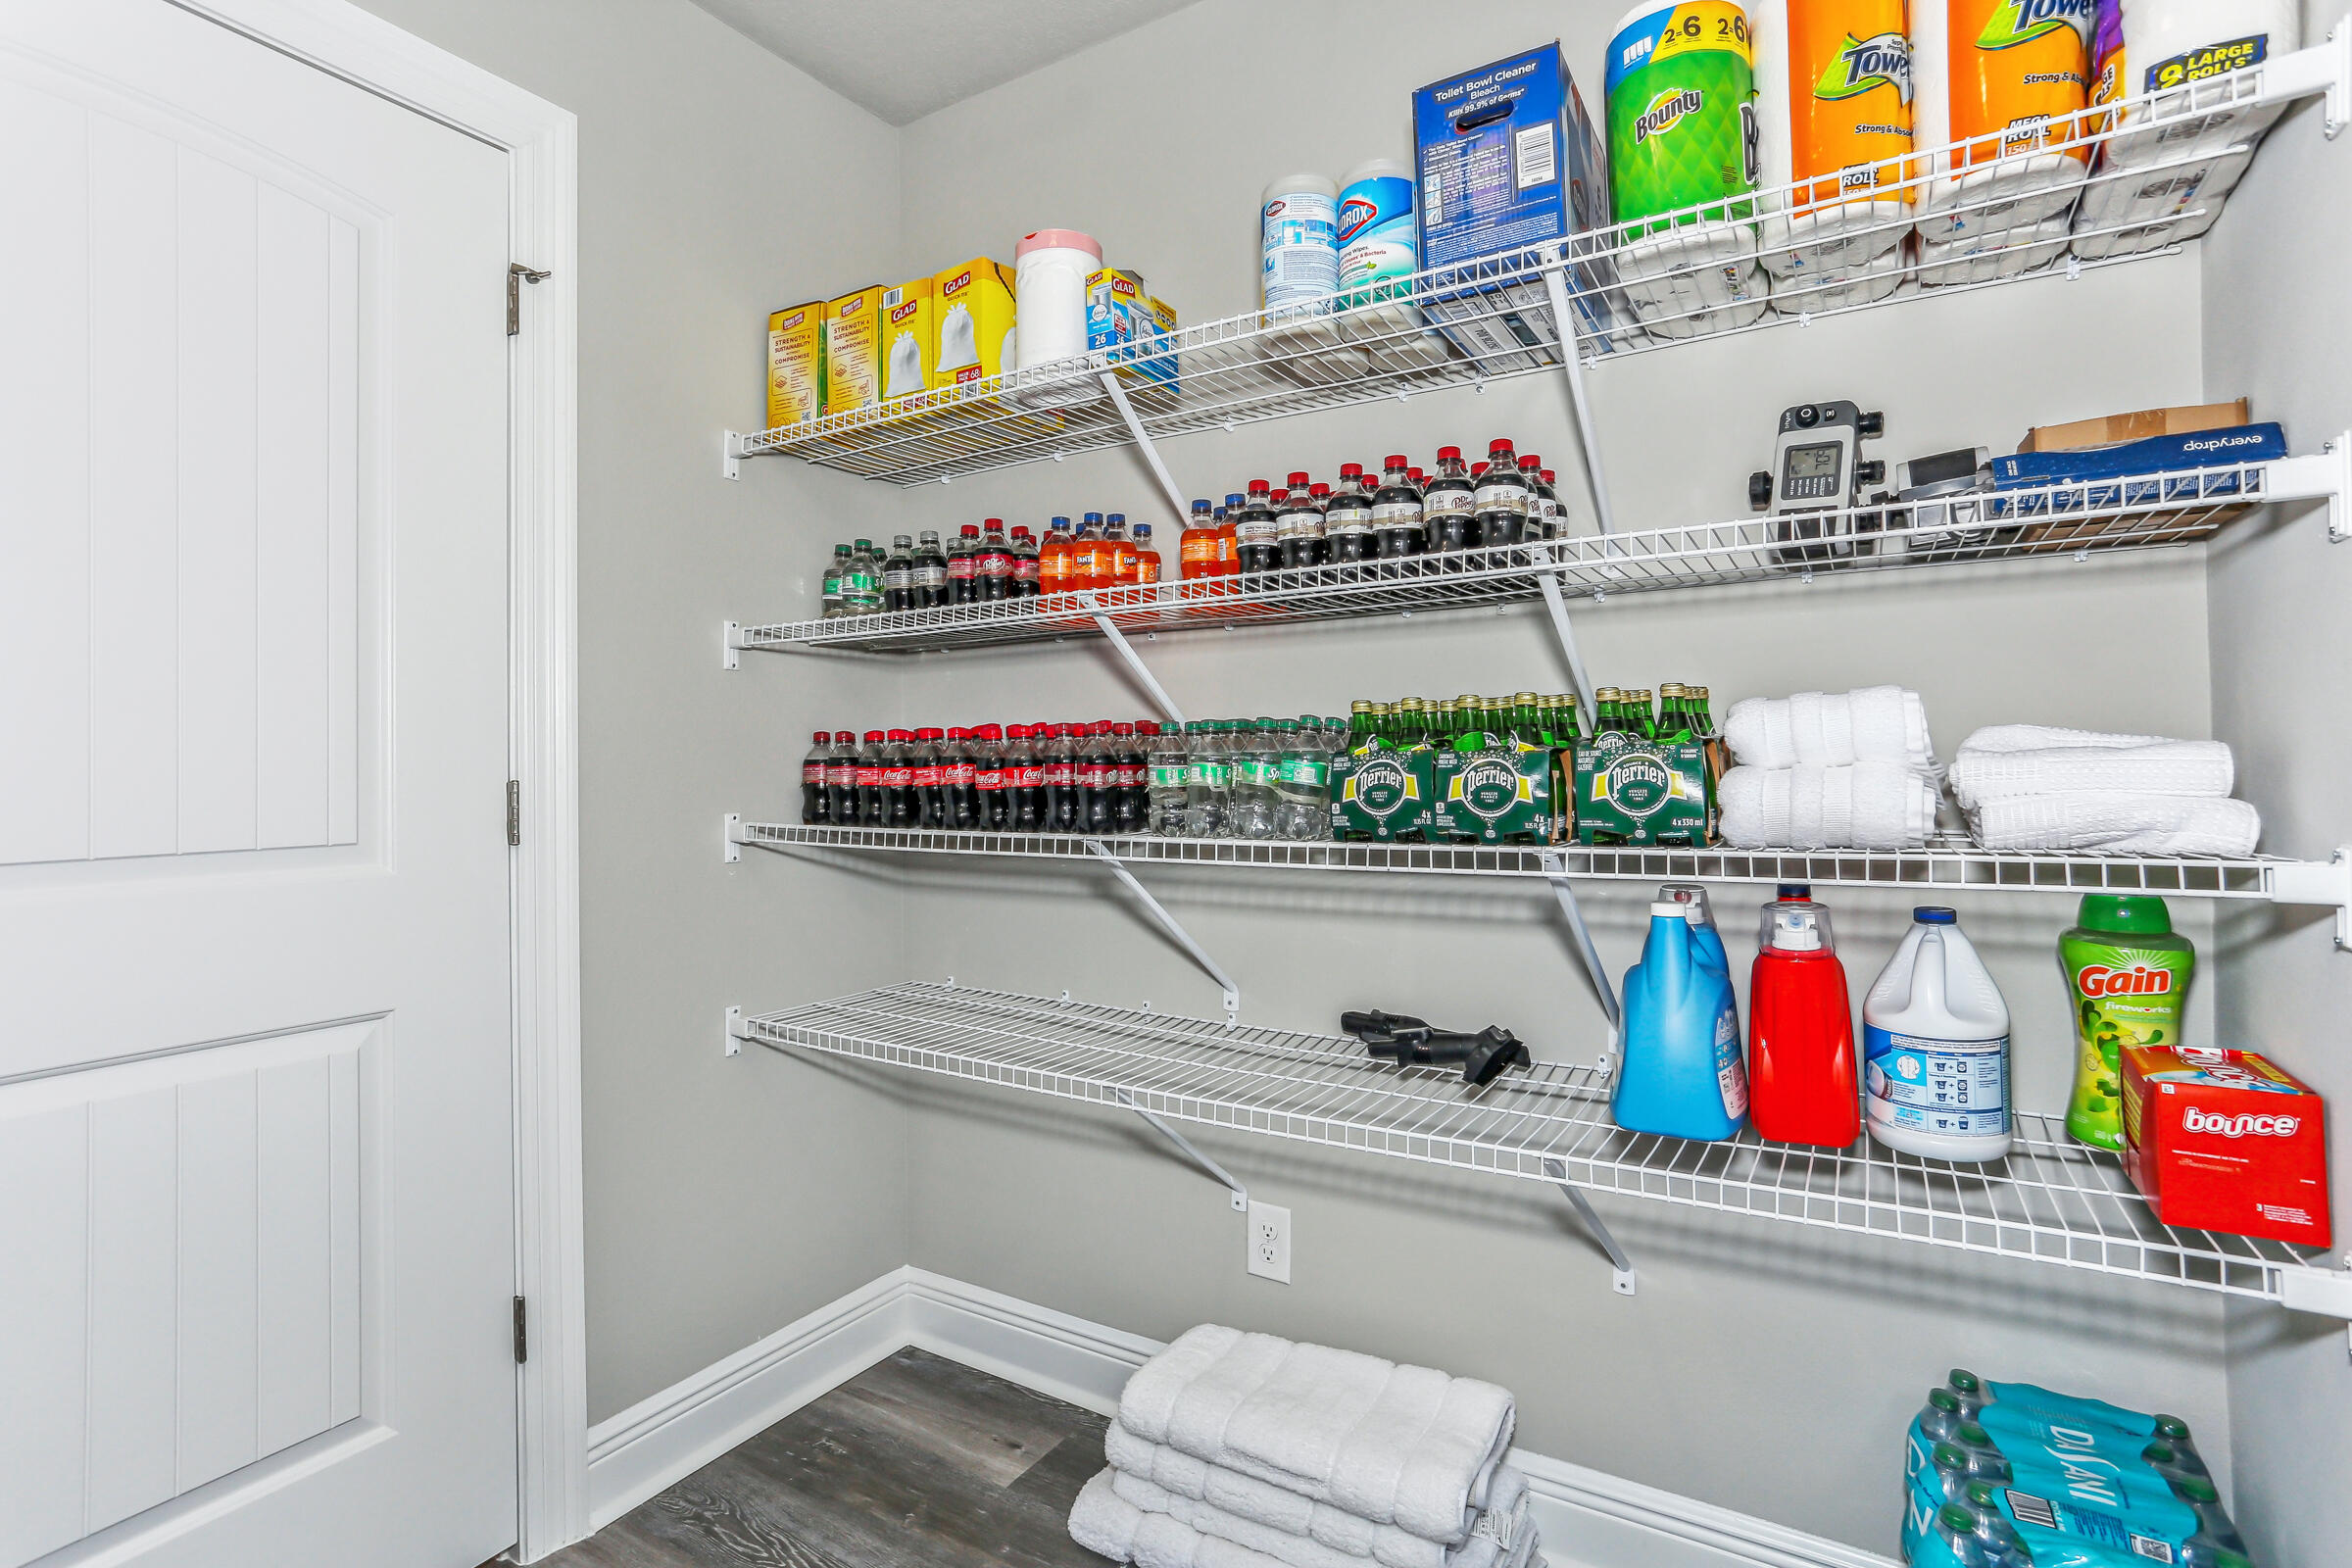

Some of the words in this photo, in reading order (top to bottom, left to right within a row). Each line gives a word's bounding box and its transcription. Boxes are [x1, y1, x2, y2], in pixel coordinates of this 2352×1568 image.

[2008, 0, 2092, 34] Towe
[2187, 43, 2253, 70] LARGE
[1842, 45, 1909, 86] Towe
[2187, 57, 2247, 81] ROLLS
[1436, 85, 1464, 102] Toilet
[1466, 74, 1493, 92] Bowl
[1495, 63, 1537, 81] Cleaner
[2023, 74, 2060, 84] Strong
[2062, 72, 2070, 80] &
[2159, 64, 2183, 89] 9
[1470, 84, 1500, 100] Bleach
[1448, 108, 1463, 119] Kills
[1464, 100, 1488, 115] 99.9%
[1490, 96, 1496, 105] of
[1636, 90, 1701, 144] Bounty
[1855, 124, 1886, 134] Strong
[1842, 173, 1879, 186] ROLL
[1340, 205, 1368, 233] LOROX
[945, 273, 970, 294] GLAD
[1087, 273, 1102, 286] GLAD
[1112, 278, 1135, 294] GLAD
[892, 301, 916, 321] GLAD
[833, 326, 870, 341] SUSTAINABILITY
[834, 320, 865, 333] STRENGTH
[774, 340, 810, 353] SUSTAINABILITY
[775, 335, 806, 346] STRENGTH
[834, 339, 870, 353] COMPROMISE
[1095, 333, 1106, 345] 26
[774, 353, 810, 366] COMPROMISE
[970, 368, 979, 379] 68
[2184, 434, 2263, 451] everydrop
[883, 770, 911, 780] Coca-Cola
[945, 766, 973, 777] Coca-Cola
[2079, 965, 2172, 996] Gain
[2104, 1002, 2173, 1014] fireworks
[2184, 1107, 2298, 1137] bounce
[2043, 1425, 2121, 1507] DASANI
